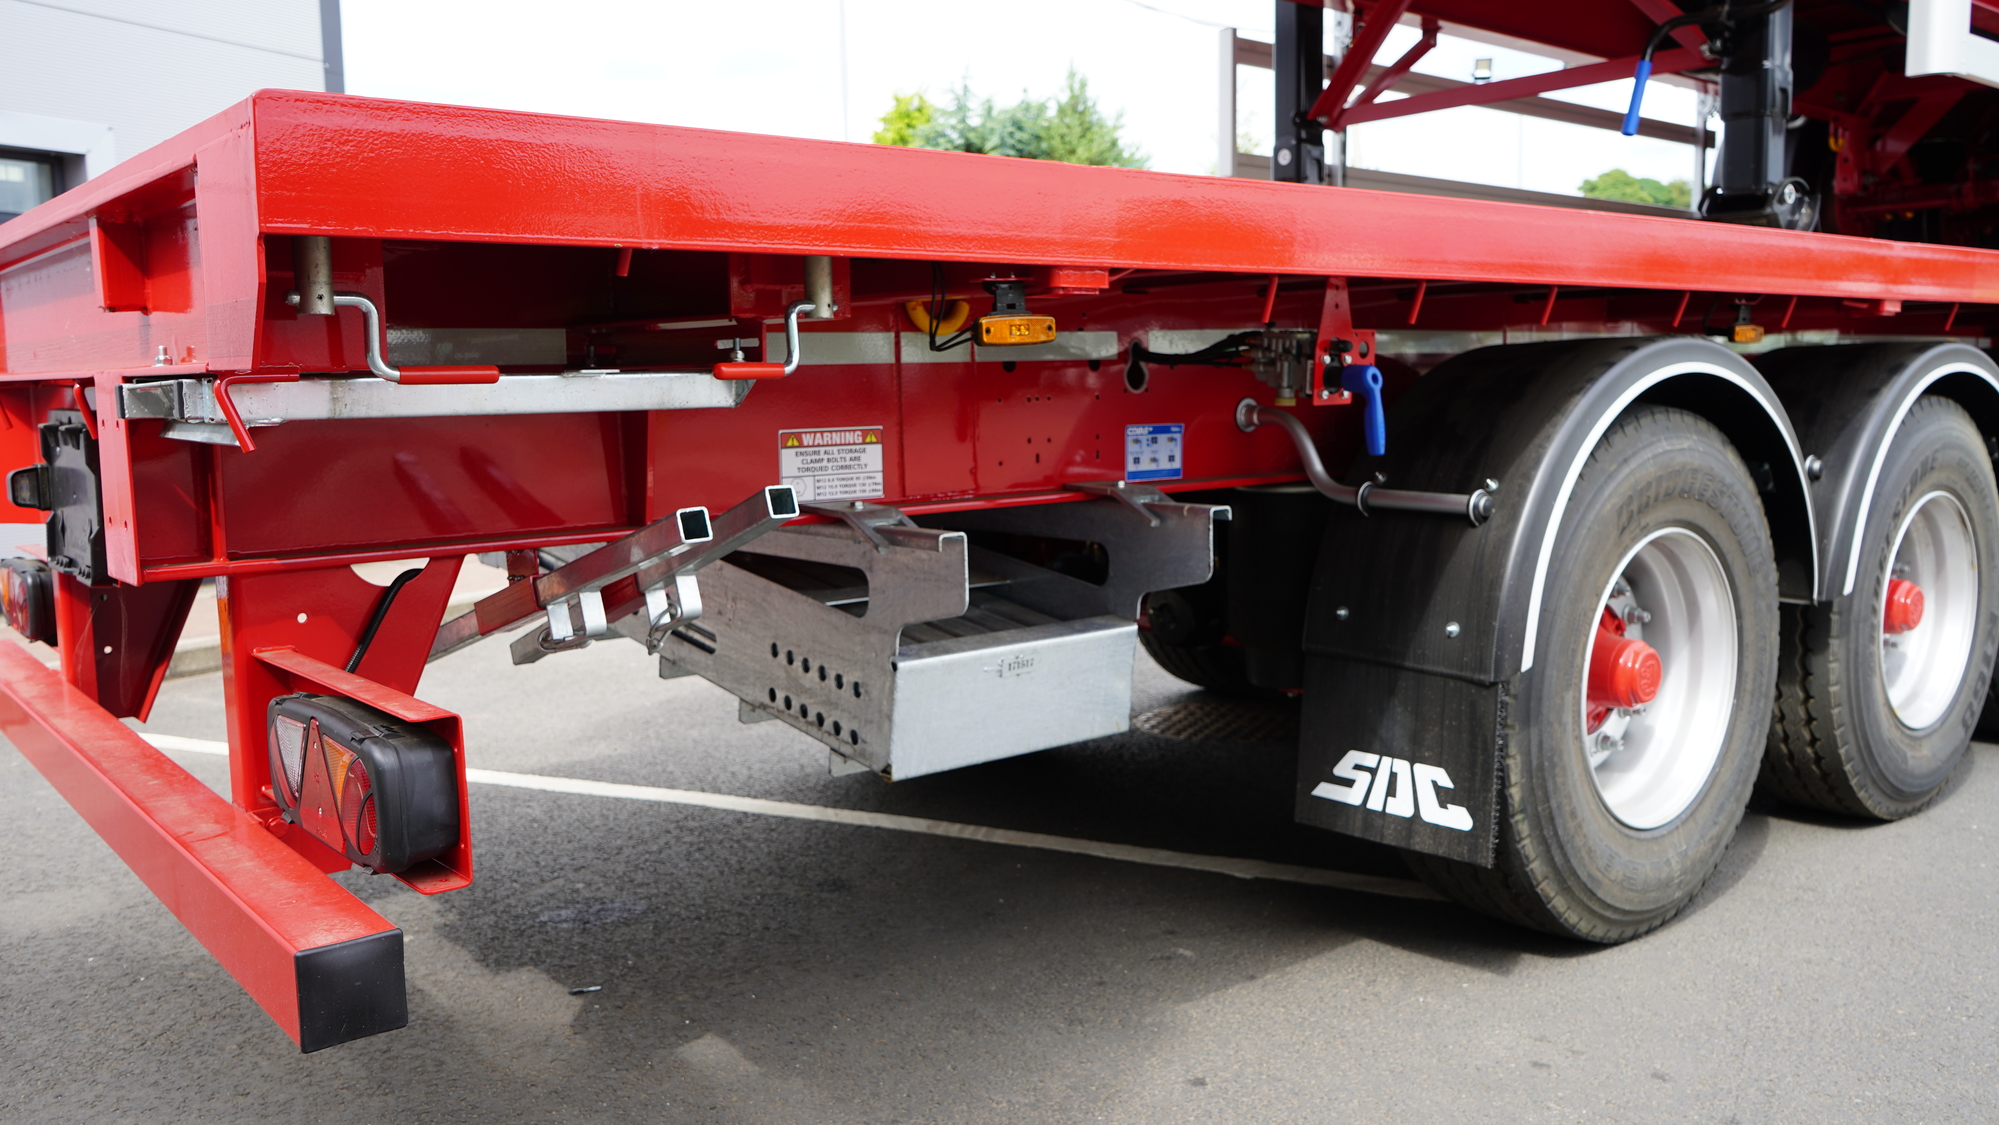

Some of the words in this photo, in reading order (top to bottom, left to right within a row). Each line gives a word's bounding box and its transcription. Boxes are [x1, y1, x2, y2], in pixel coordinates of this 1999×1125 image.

[801, 430, 862, 446] WARNING
[837, 447, 867, 455] STORAGE
[831, 463, 868, 471] CORRECTLY
[1311, 750, 1473, 831] SDC
